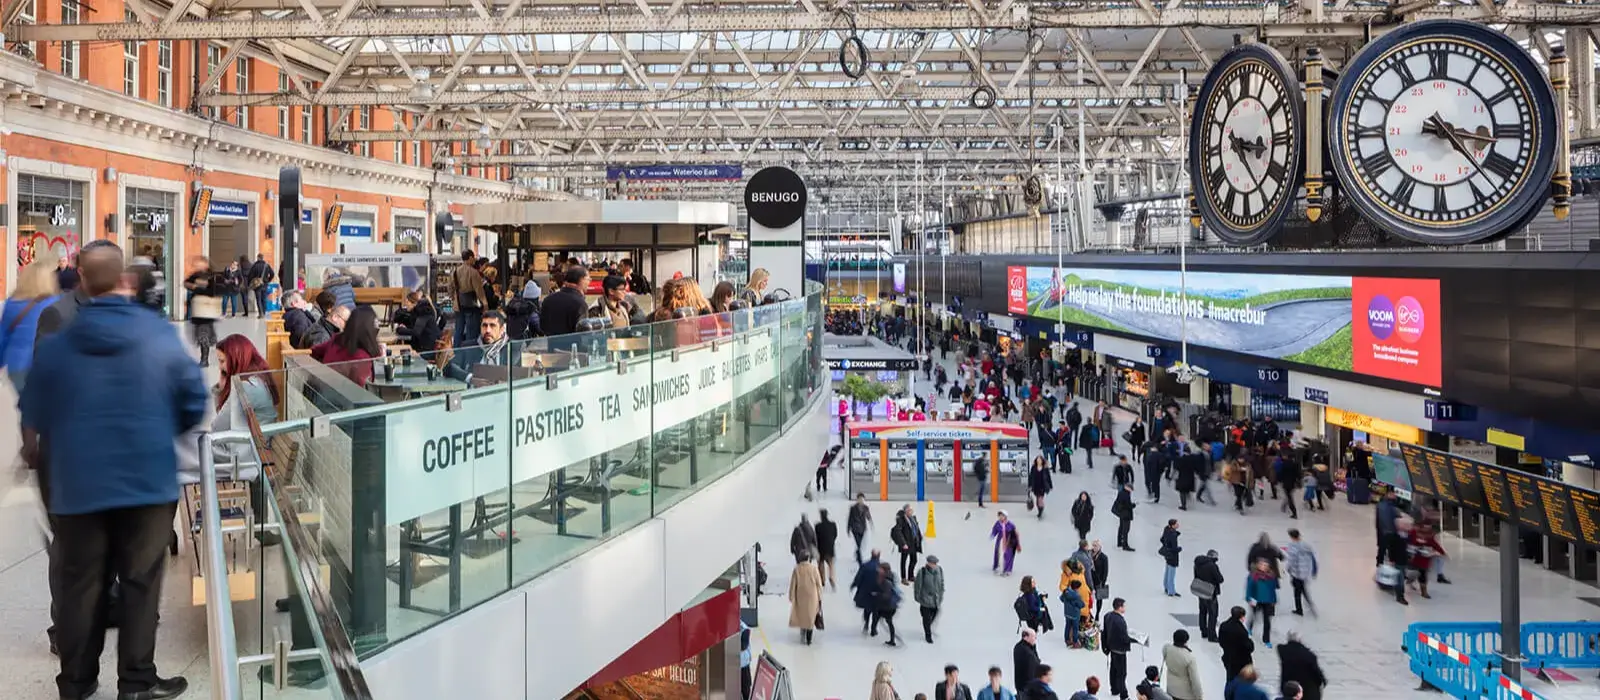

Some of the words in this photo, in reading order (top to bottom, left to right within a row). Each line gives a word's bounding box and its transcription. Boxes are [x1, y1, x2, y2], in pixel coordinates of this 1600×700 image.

[1433, 81, 1446, 90] 00
[1411, 88, 1423, 96] 23
[1456, 88, 1468, 96] 13
[1394, 105, 1407, 113] 22
[1389, 127, 1400, 135] 21
[1394, 149, 1407, 157] 20
[673, 168, 702, 176] Waterloo
[704, 168, 718, 176] East
[1411, 166, 1423, 174] 19
[1457, 167, 1470, 175] 17
[1434, 174, 1446, 182] 18
[751, 191, 800, 203] BENUGO
[1069, 284, 1086, 310] Help
[1087, 290, 1099, 304] us
[1099, 284, 1114, 313] lay
[1115, 286, 1131, 309] the
[1132, 287, 1205, 319] foundations
[1208, 301, 1267, 326] #macrebur
[1368, 309, 1394, 323] VOOM
[1082, 332, 1089, 342] 8
[1155, 347, 1161, 357] 9
[1266, 370, 1280, 381] 10
[1426, 403, 1435, 418] 11
[1441, 404, 1453, 418] 11
[422, 424, 495, 474] COFFEE
[515, 402, 584, 448] PASTRIES
[599, 393, 621, 421] TEA
[633, 373, 690, 412] SANDWICHES
[698, 365, 716, 390] JUICE
[906, 429, 947, 438] Self-service
[948, 429, 972, 438] tickets
[670, 664, 697, 685] HELLO!
